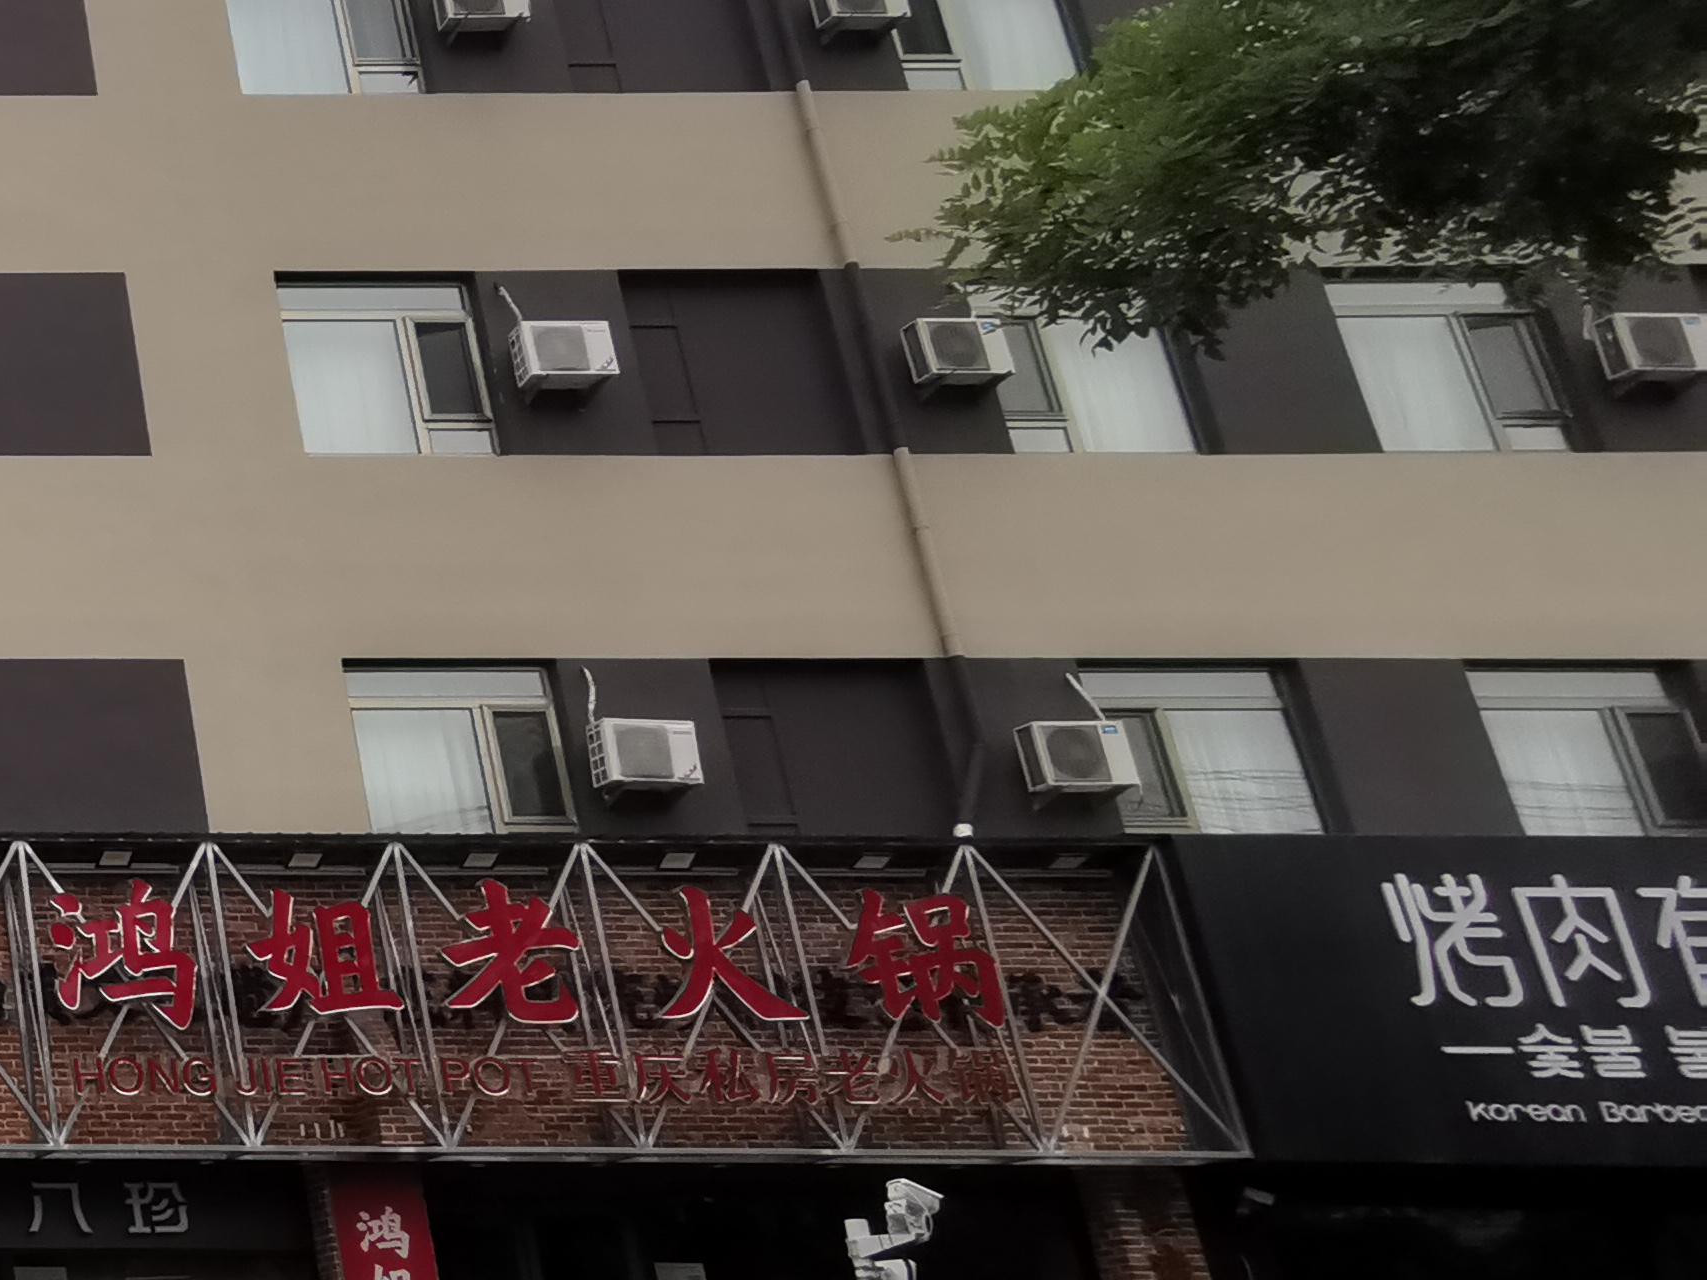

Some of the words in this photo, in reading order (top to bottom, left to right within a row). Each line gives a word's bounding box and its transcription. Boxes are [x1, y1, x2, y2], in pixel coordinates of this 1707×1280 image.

[49, 879, 1005, 1030] 鸿姐老火锅
[72, 1056, 218, 1097] HONG
[237, 1056, 307, 1097] JIE
[323, 1056, 423, 1097] HOT
[442, 1056, 536, 1097] POT
[572, 1047, 1024, 1106] 重庆私房老火锅
[1464, 1099, 1588, 1124] Korean
